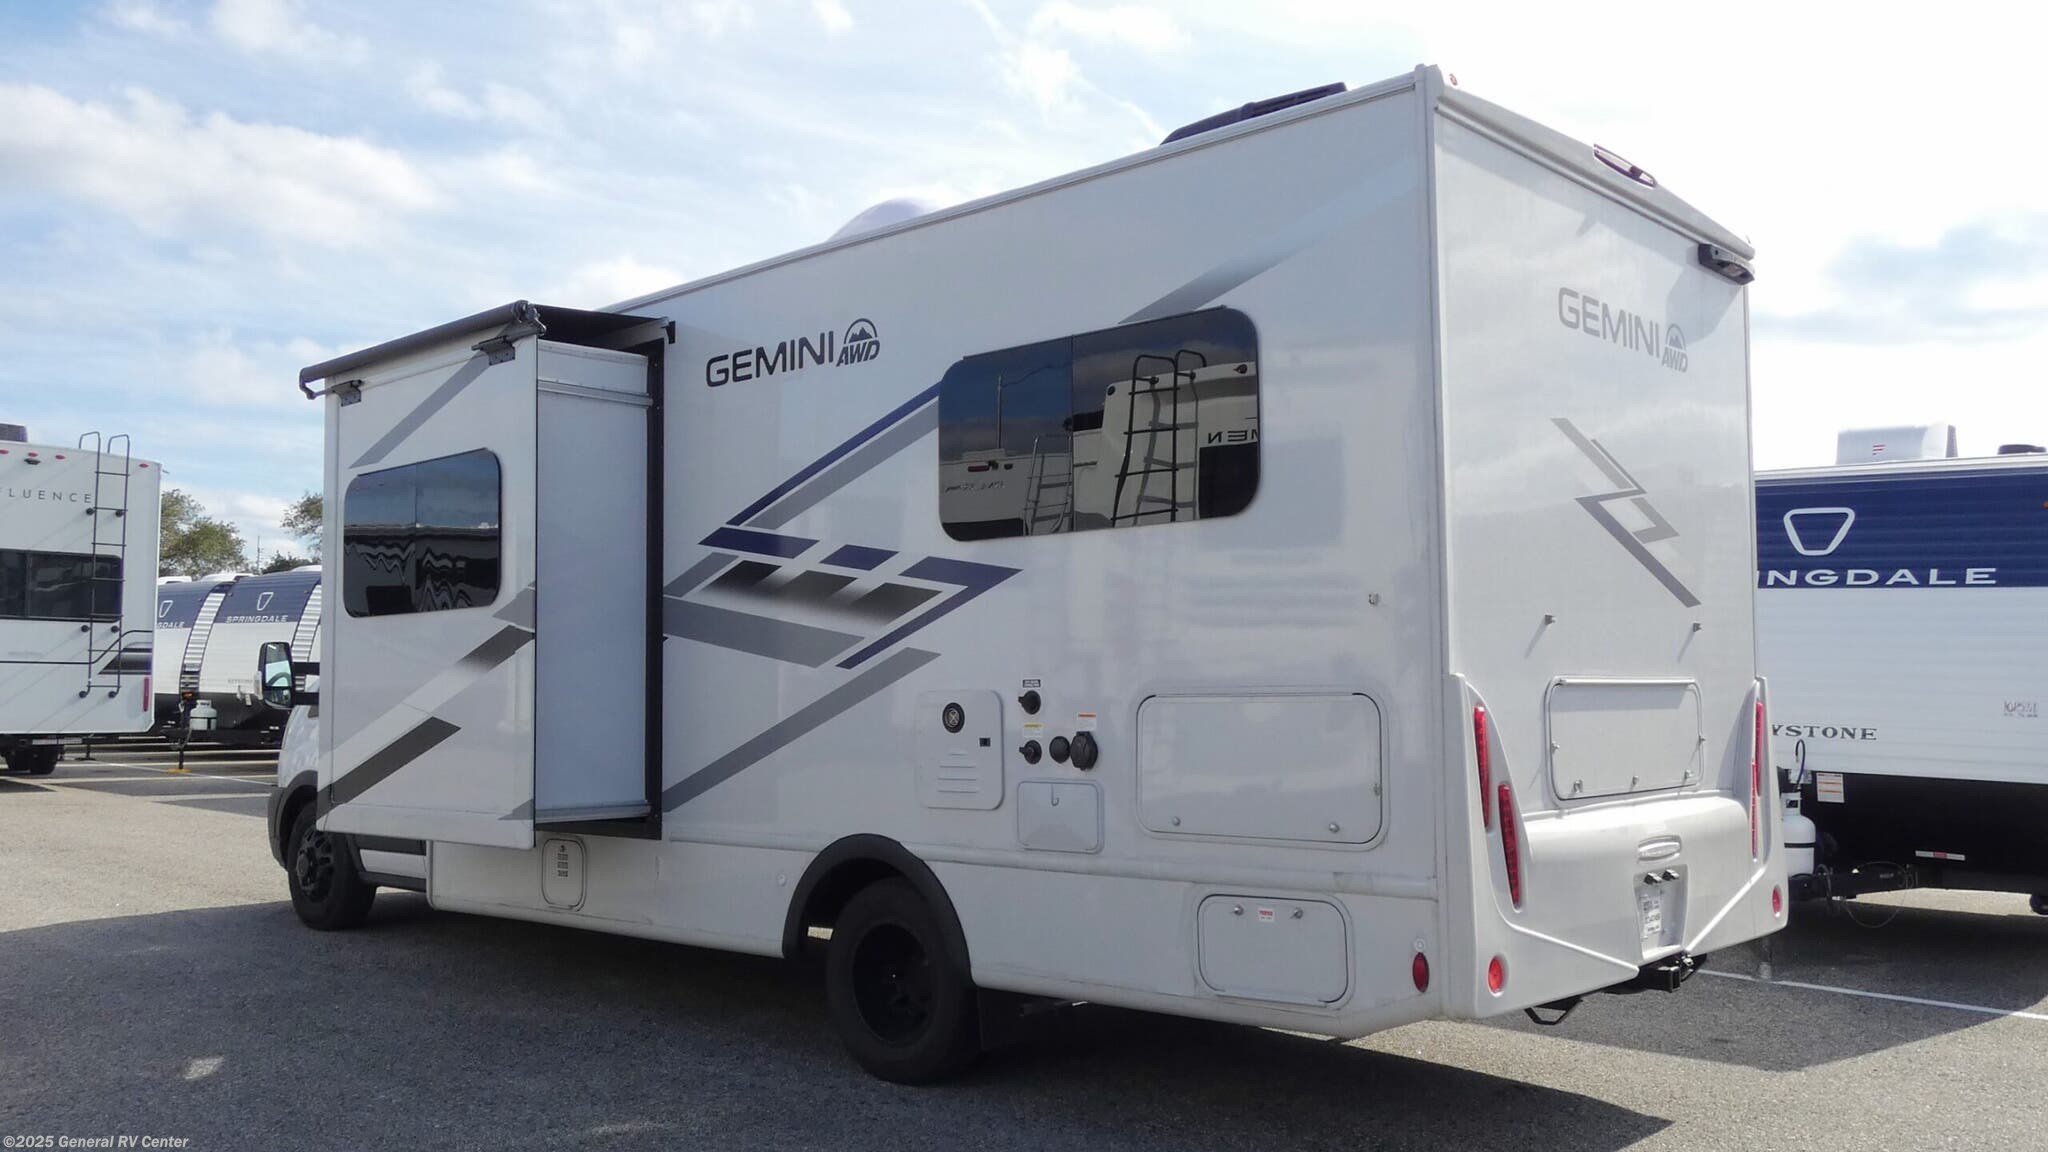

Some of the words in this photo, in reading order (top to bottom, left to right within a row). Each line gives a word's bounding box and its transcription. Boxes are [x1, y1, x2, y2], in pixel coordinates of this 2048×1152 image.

[1558, 287, 1660, 359] GEMINI
[1661, 346, 1689, 374] AWD
[705, 330, 834, 388] GEMINI
[836, 340, 881, 368] AWD
[0, 487, 92, 504] LUENCE
[226, 615, 289, 624] SPRINGDALE
[1771, 724, 1878, 741] YSTONE
